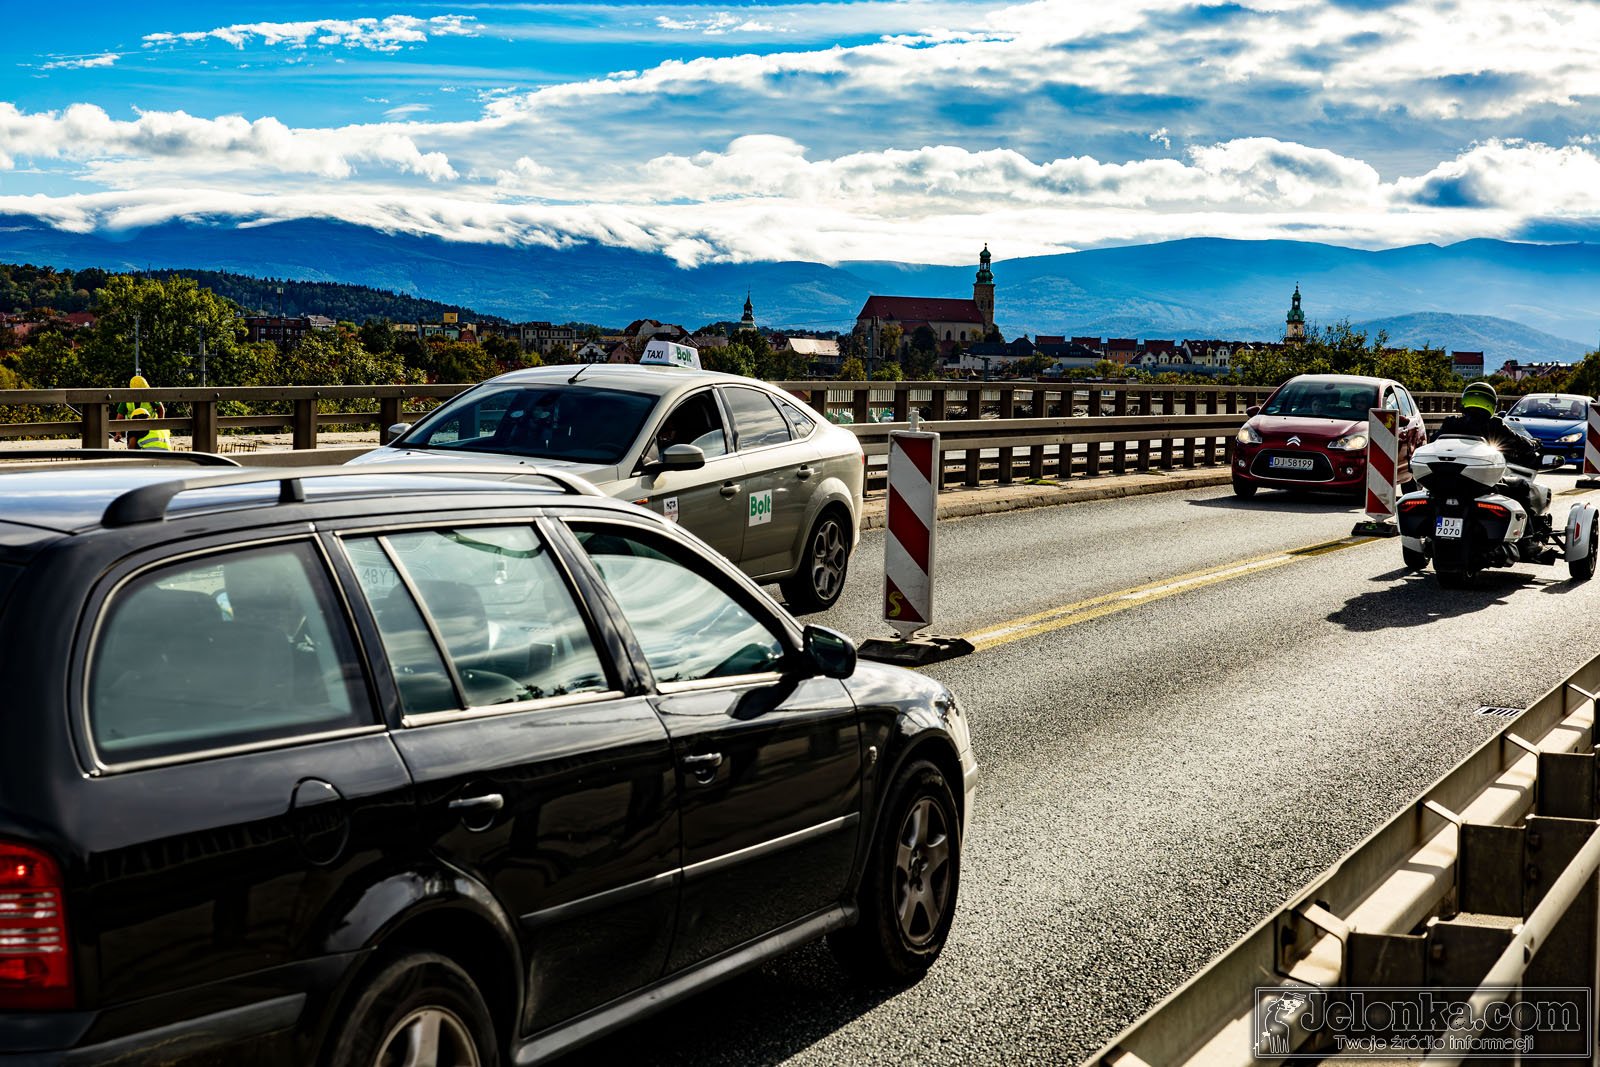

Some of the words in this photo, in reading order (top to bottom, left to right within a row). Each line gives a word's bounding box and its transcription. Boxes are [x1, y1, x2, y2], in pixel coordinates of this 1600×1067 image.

[647, 349, 664, 359] TAXI
[676, 346, 692, 363] Bolt
[1274, 457, 1285, 466] DJ
[1287, 458, 1313, 468] 58199
[750, 494, 771, 517] Bolt
[1444, 519, 1455, 527] DJ
[1437, 527, 1460, 536] 7070
